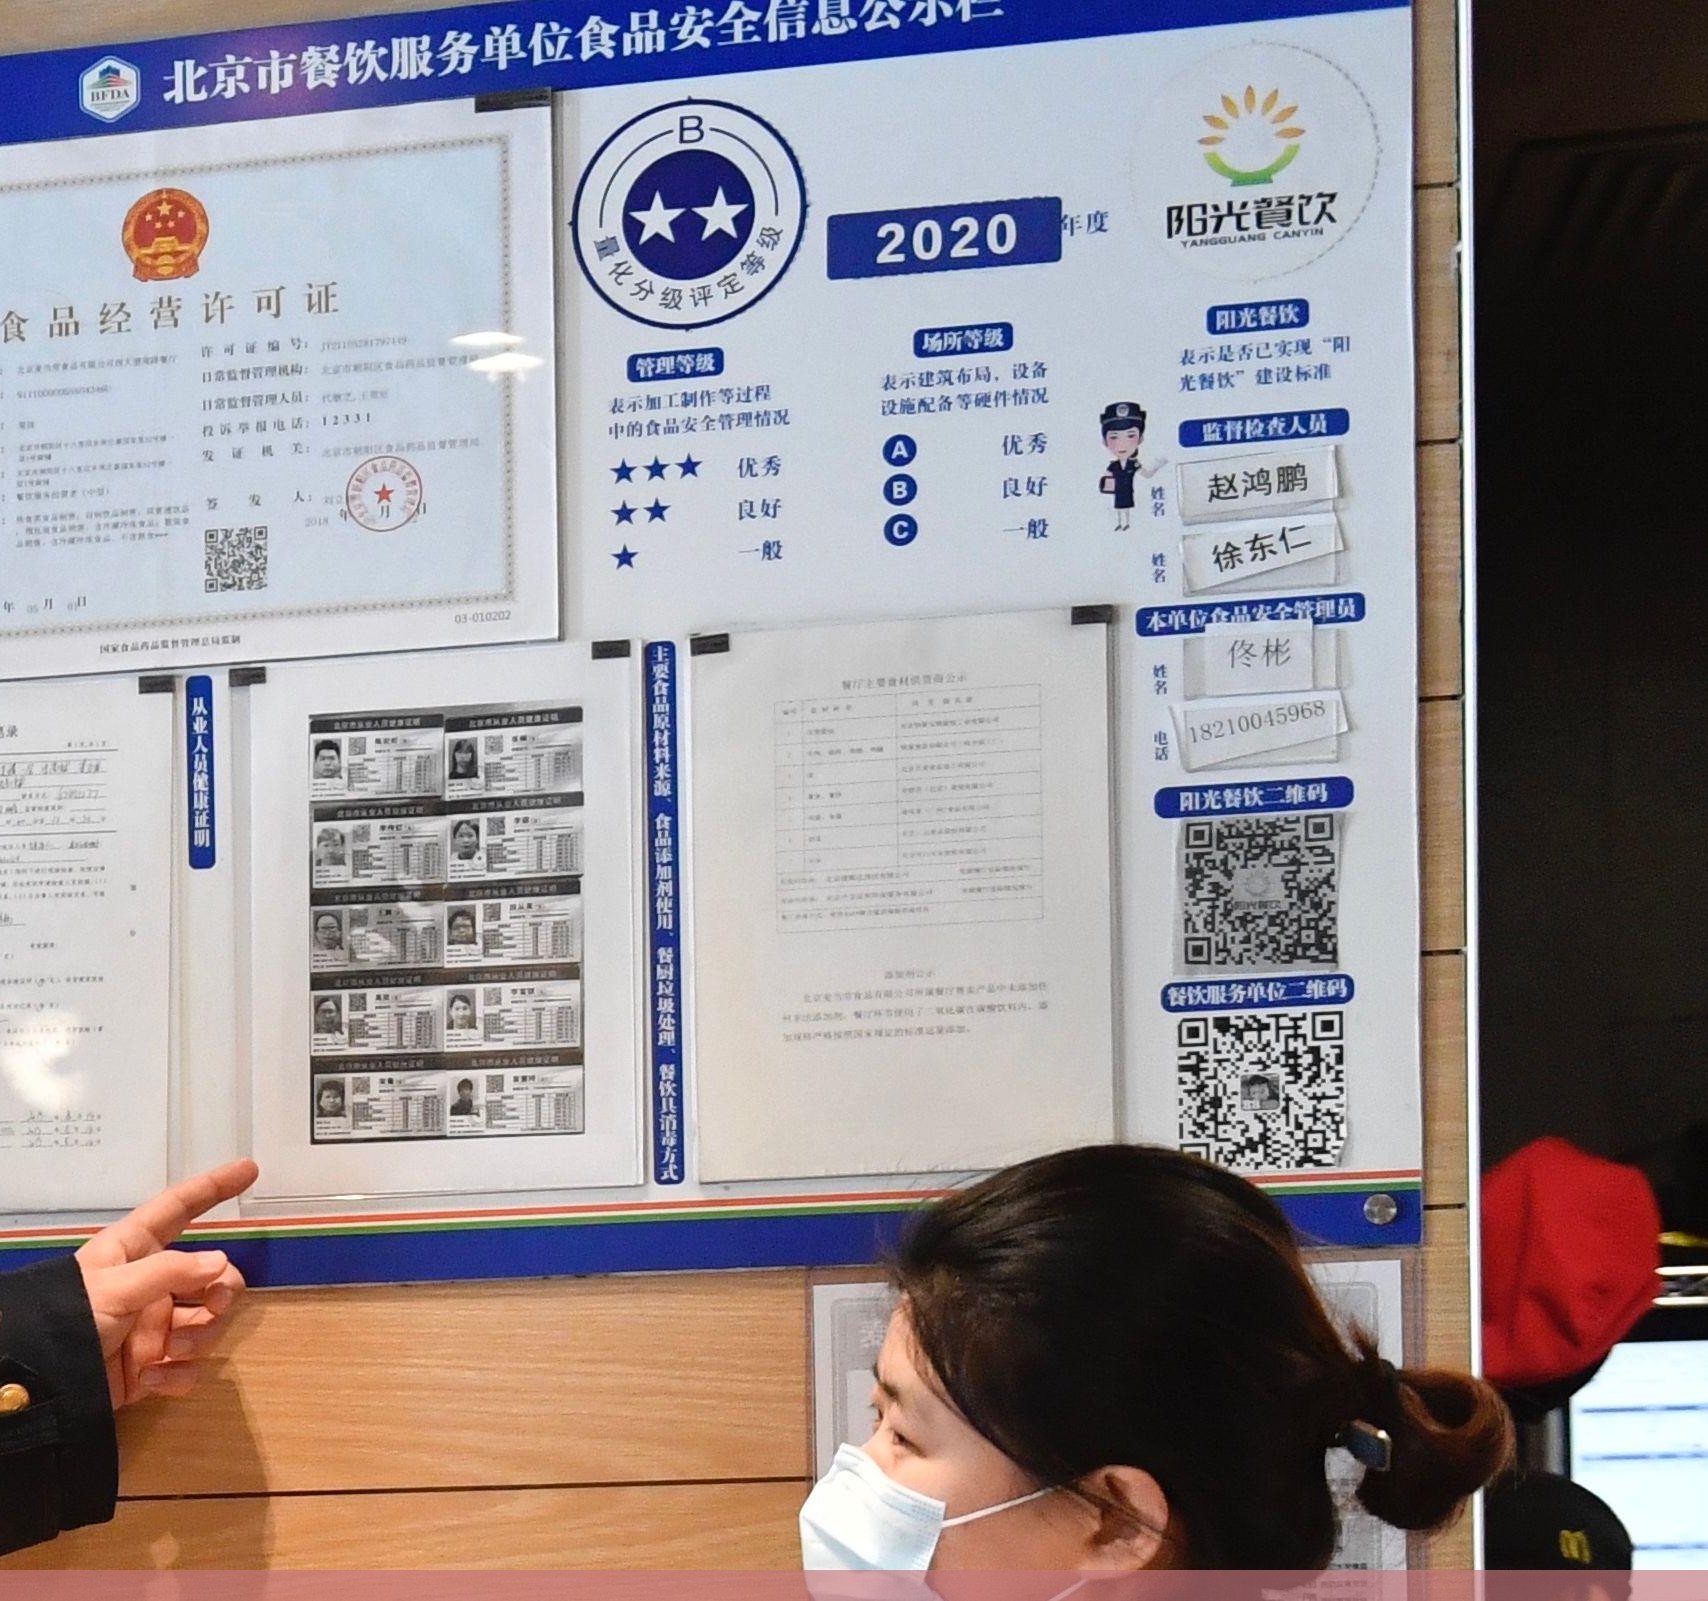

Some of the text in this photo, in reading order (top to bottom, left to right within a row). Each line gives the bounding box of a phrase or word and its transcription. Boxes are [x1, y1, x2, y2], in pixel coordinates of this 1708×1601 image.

[91, 89, 130, 102] BFDA
[679, 115, 705, 144] B
[1061, 210, 1109, 237] 年度
[1167, 192, 1338, 239] 阳光餐饮
[876, 213, 1017, 264] 2020
[1181, 228, 1324, 248] YANGGUANG CANYIN
[593, 226, 783, 310] 量化分级评定等级
[1215, 302, 1300, 330] 阳光餐饮
[922, 327, 1004, 352] 场所等级
[636, 353, 715, 378] 管理等级
[608, 384, 771, 414] 表示加工制作等过程
[881, 388, 1049, 416] 设施配备等硬件情况
[608, 409, 790, 439] 中的食品安全管理情况
[1202, 413, 1327, 443] 监督检查人员
[891, 433, 1048, 459] A 优秀
[738, 455, 782, 478] 优秀
[892, 475, 1048, 498] B 良好
[1208, 463, 1308, 502] 赵鸿鹏
[738, 499, 782, 520] 良好
[1151, 486, 1166, 517] 姓名
[892, 518, 1049, 539] C 一般
[739, 540, 783, 561] 一般
[1212, 525, 1312, 573] 徐东仁
[1152, 552, 1166, 583] 姓名
[454, 610, 512, 625] 03-010202
[1146, 598, 1356, 631] 本单位食品安全管理员
[1228, 638, 1291, 669] 佟彬
[1153, 664, 1168, 695] 姓名
[1189, 700, 1326, 744] 18210045968
[1154, 731, 1169, 761] 电话
[192, 697, 210, 848] 从业人员健康证明
[1179, 782, 1327, 811] 阳光餐饮二维码
[1167, 977, 1348, 1007] 餐饮服务单位二维码
